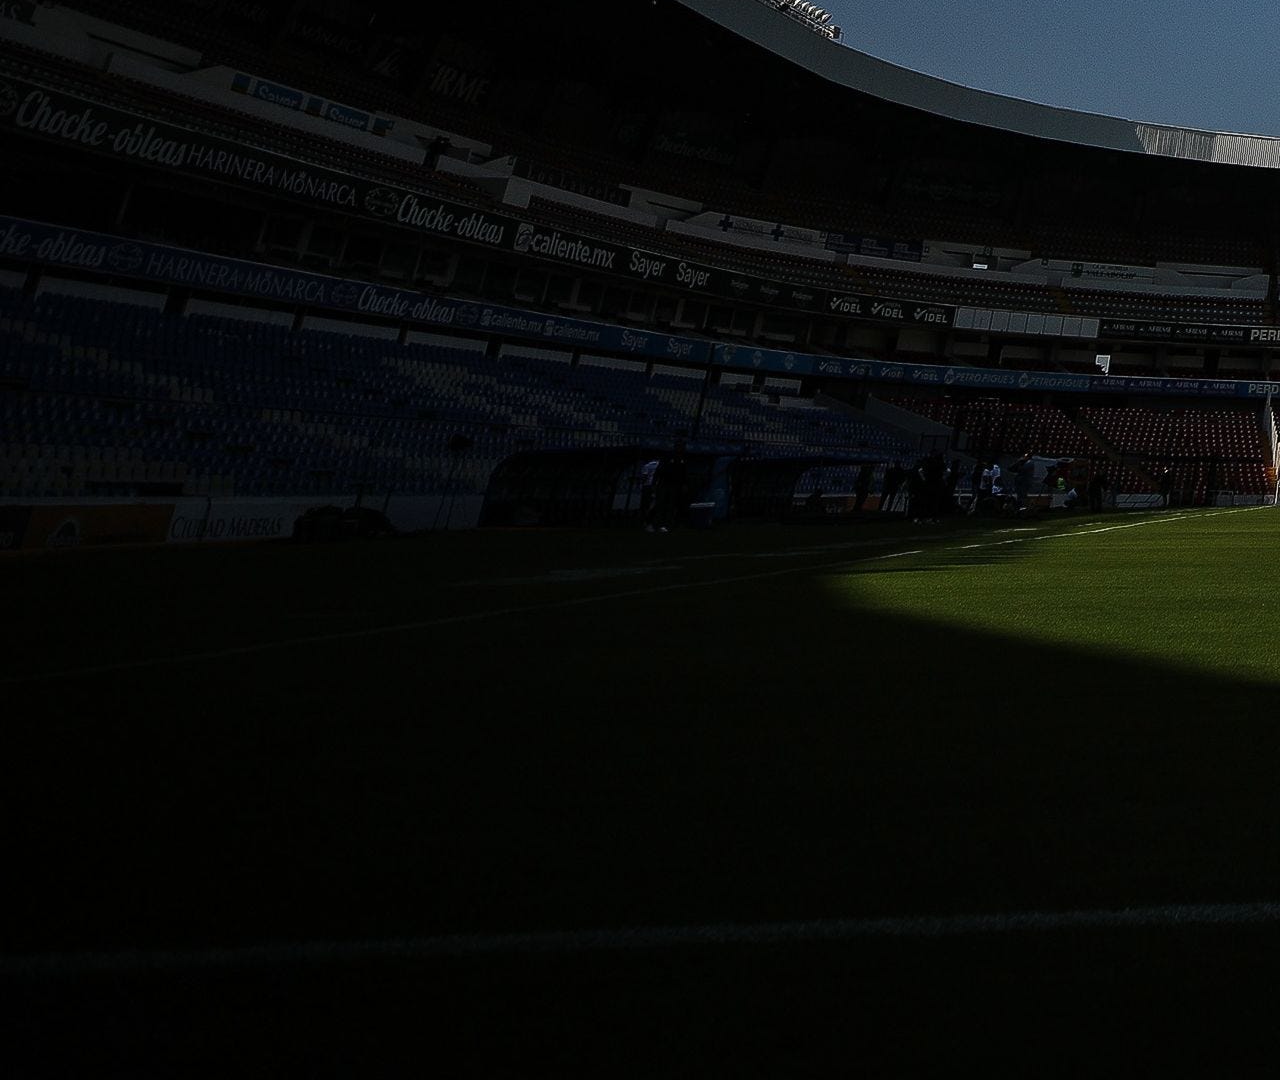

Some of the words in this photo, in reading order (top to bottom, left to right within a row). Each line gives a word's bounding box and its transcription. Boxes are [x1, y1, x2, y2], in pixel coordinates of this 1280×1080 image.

[187, 147, 274, 185] HARINERA
[532, 231, 616, 270] caliente.mx
[629, 251, 666, 280] Sayer
[676, 262, 710, 289] Sayer
[621, 330, 649, 352] Sayer
[666, 337, 694, 358] Sayer
